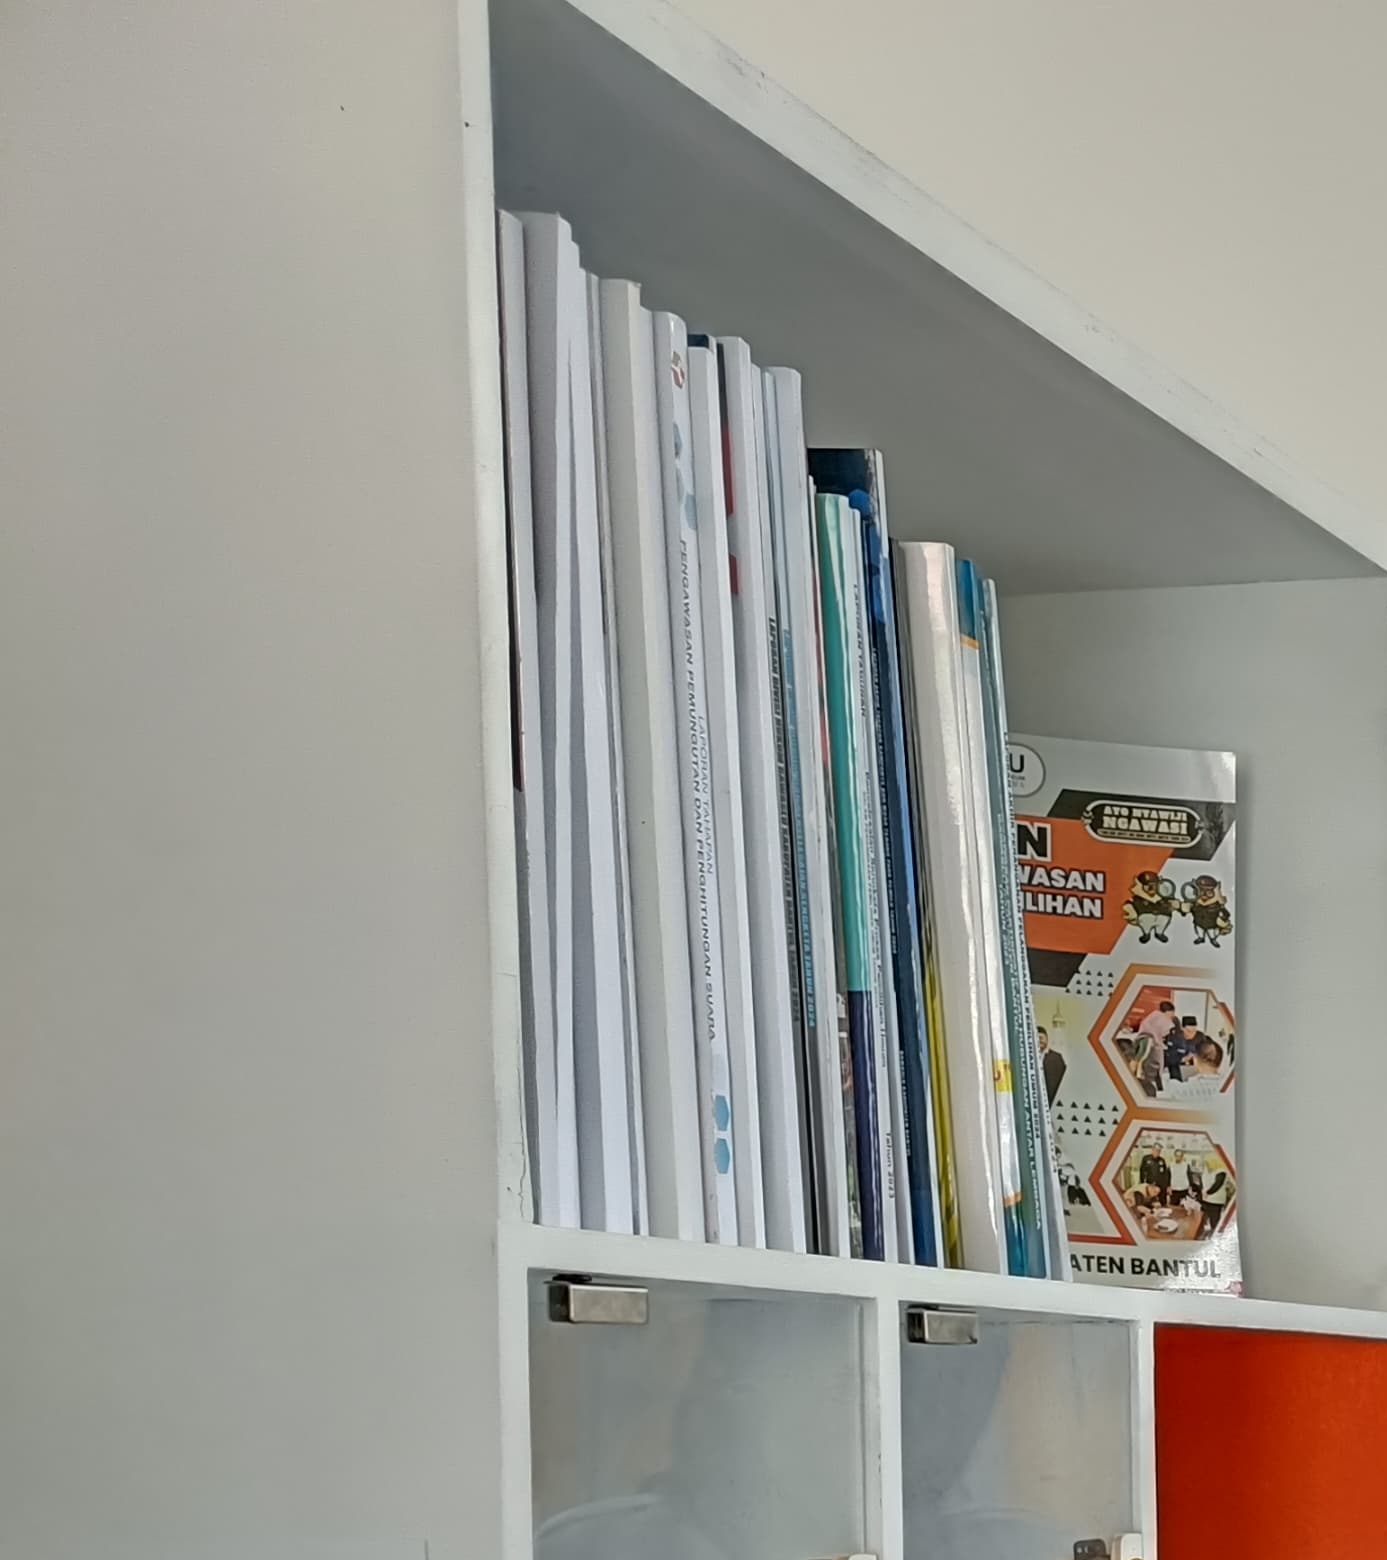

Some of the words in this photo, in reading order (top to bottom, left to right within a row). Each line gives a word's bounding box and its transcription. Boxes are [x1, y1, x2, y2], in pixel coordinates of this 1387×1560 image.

[678, 538, 693, 665] PENGAWASAN
[686, 669, 700, 792] PEMUNGUTAN
[697, 714, 709, 794] LAPORAN
[693, 797, 702, 833] DAN
[702, 799, 713, 874] TAHAPAN
[1102, 815, 1188, 835] NGAWASI
[695, 838, 712, 977] PENGHITUNGAN
[704, 982, 716, 1042] SUARA
[1131, 1257, 1221, 1278] BANTUL
